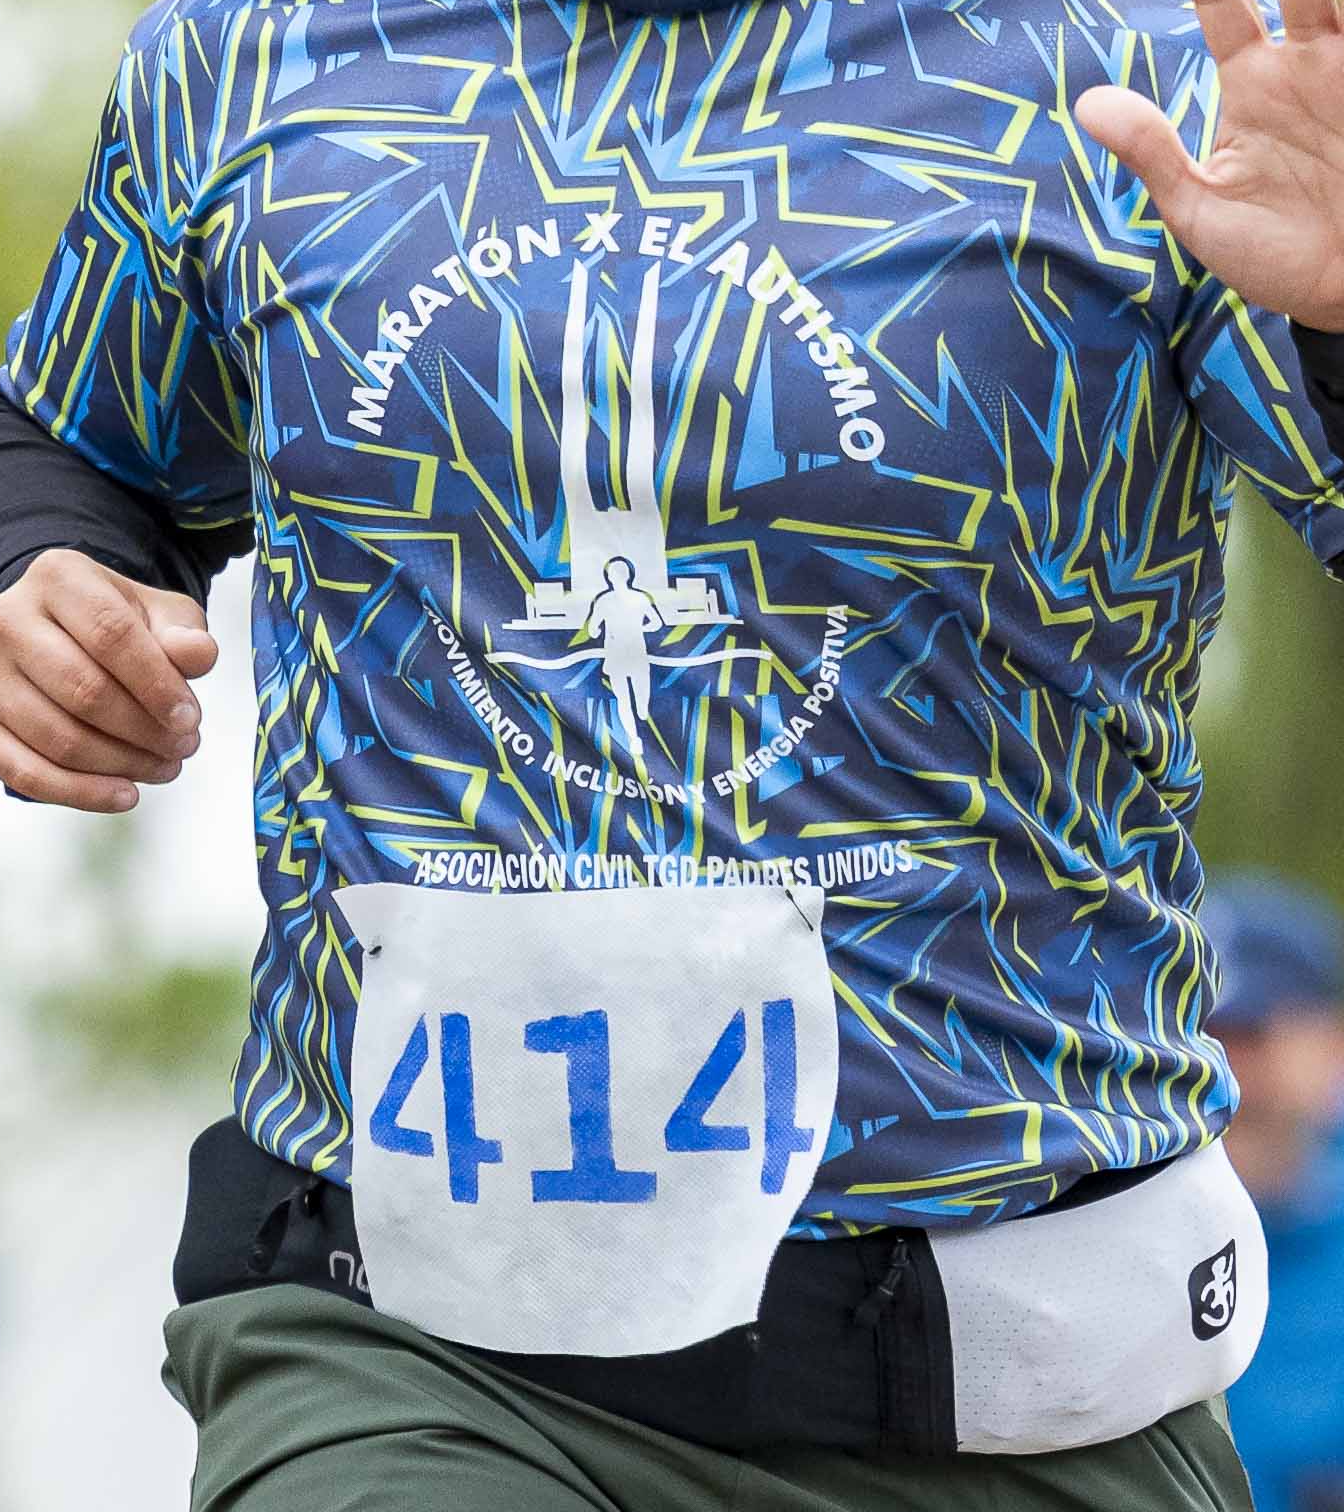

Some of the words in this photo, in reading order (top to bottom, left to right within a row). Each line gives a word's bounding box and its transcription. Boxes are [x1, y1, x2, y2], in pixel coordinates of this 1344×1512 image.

[347, 218, 561, 436] MARATÓN
[580, 213, 623, 252] X
[639, 216, 694, 265] EL
[706, 240, 885, 461] AUTISMO
[542, 751, 689, 805] INCLUSIÓN
[687, 780, 705, 804] Y
[711, 715, 814, 796] ENERGÍA
[802, 604, 848, 716] POSITIVA
[414, 843, 566, 890] ASOCIACIÓN
[574, 854, 641, 889] CIVIL
[643, 854, 698, 888] TGD
[707, 855, 812, 888] PADRES
[817, 840, 913, 889] UNIDOS
[369, 998, 814, 1204] 414
